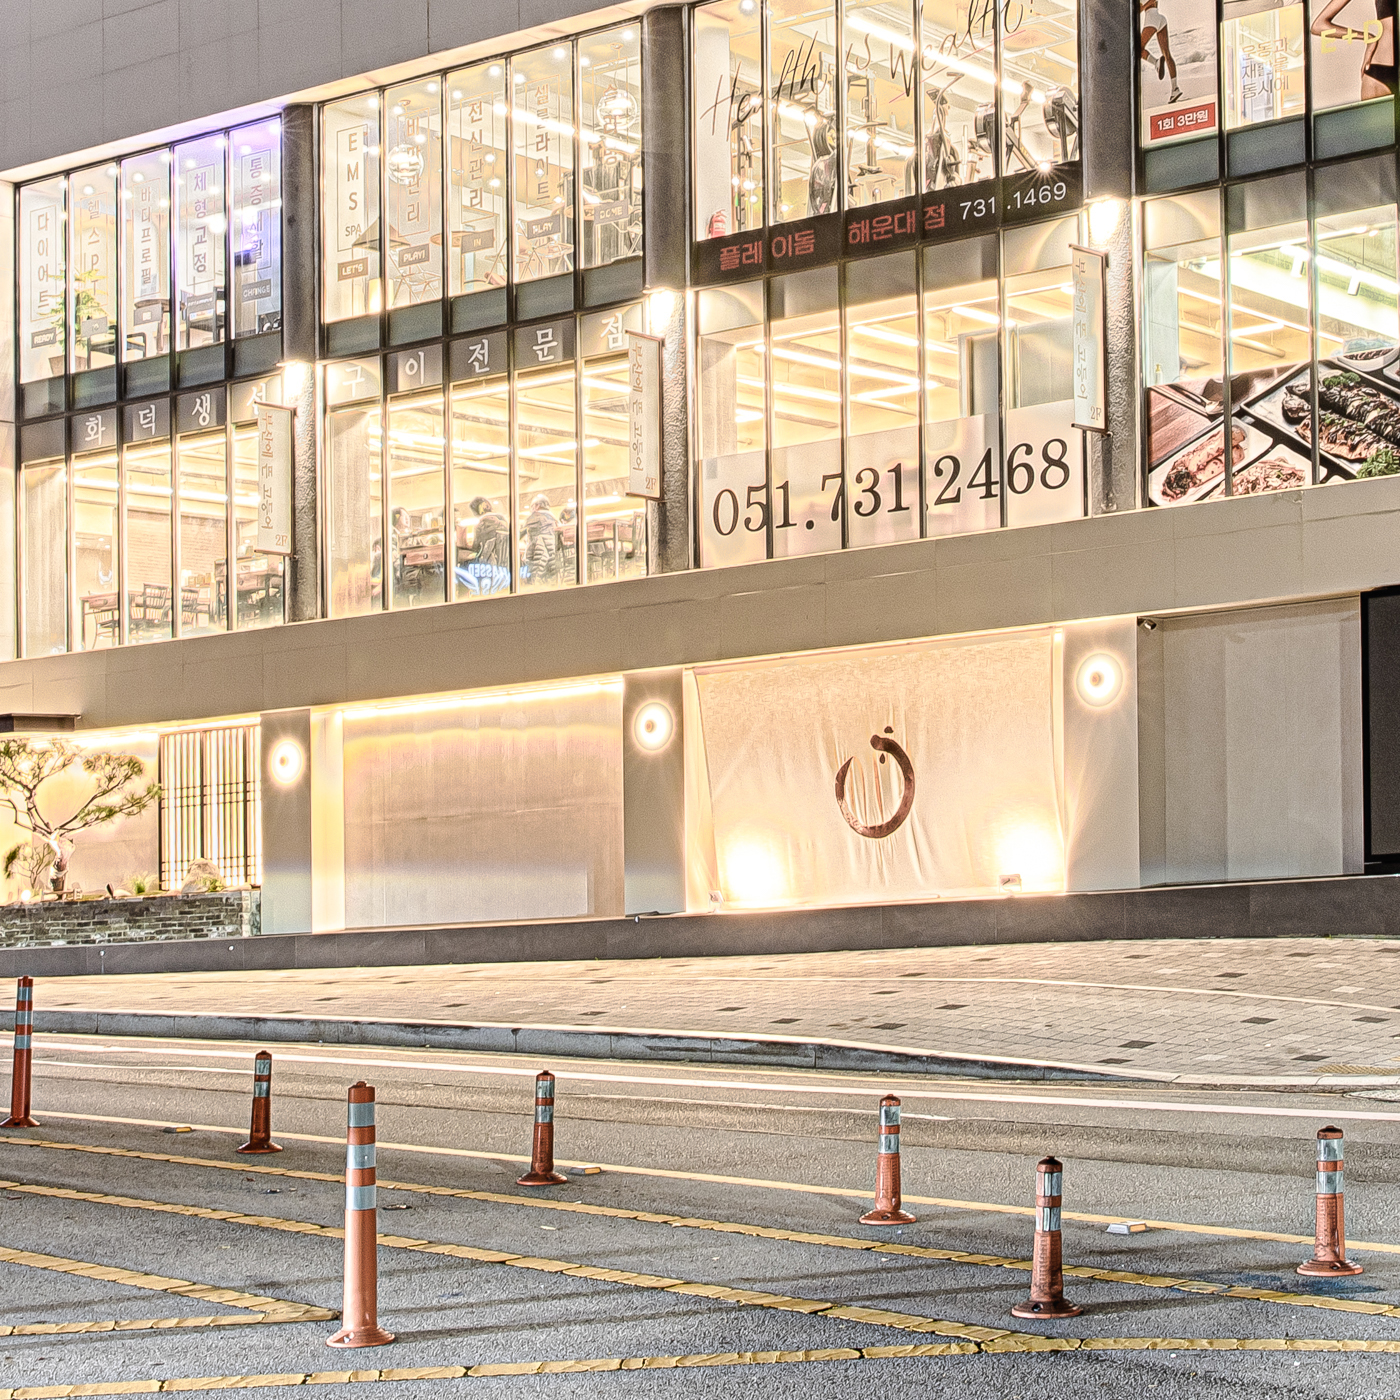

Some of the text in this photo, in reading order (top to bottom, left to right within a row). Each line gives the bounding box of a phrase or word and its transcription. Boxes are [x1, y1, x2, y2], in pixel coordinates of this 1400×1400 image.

[1241, 37, 1288, 61] 운동과
[1320, 20, 1383, 54] E+D
[846, 33, 871, 71] is
[1242, 77, 1290, 99] 동시에
[1157, 110, 1209, 131] 1회 3만원
[467, 100, 485, 209] 전신관리
[347, 131, 361, 213] EMS
[140, 186, 152, 285] 바디프로필
[193, 171, 208, 274] 체형교정
[344, 223, 362, 238] SPA
[37, 212, 51, 309] 다이어트
[1090, 406, 1102, 421] 2F
[645, 477, 657, 490] 2F
[275, 534, 288, 548] 2F
